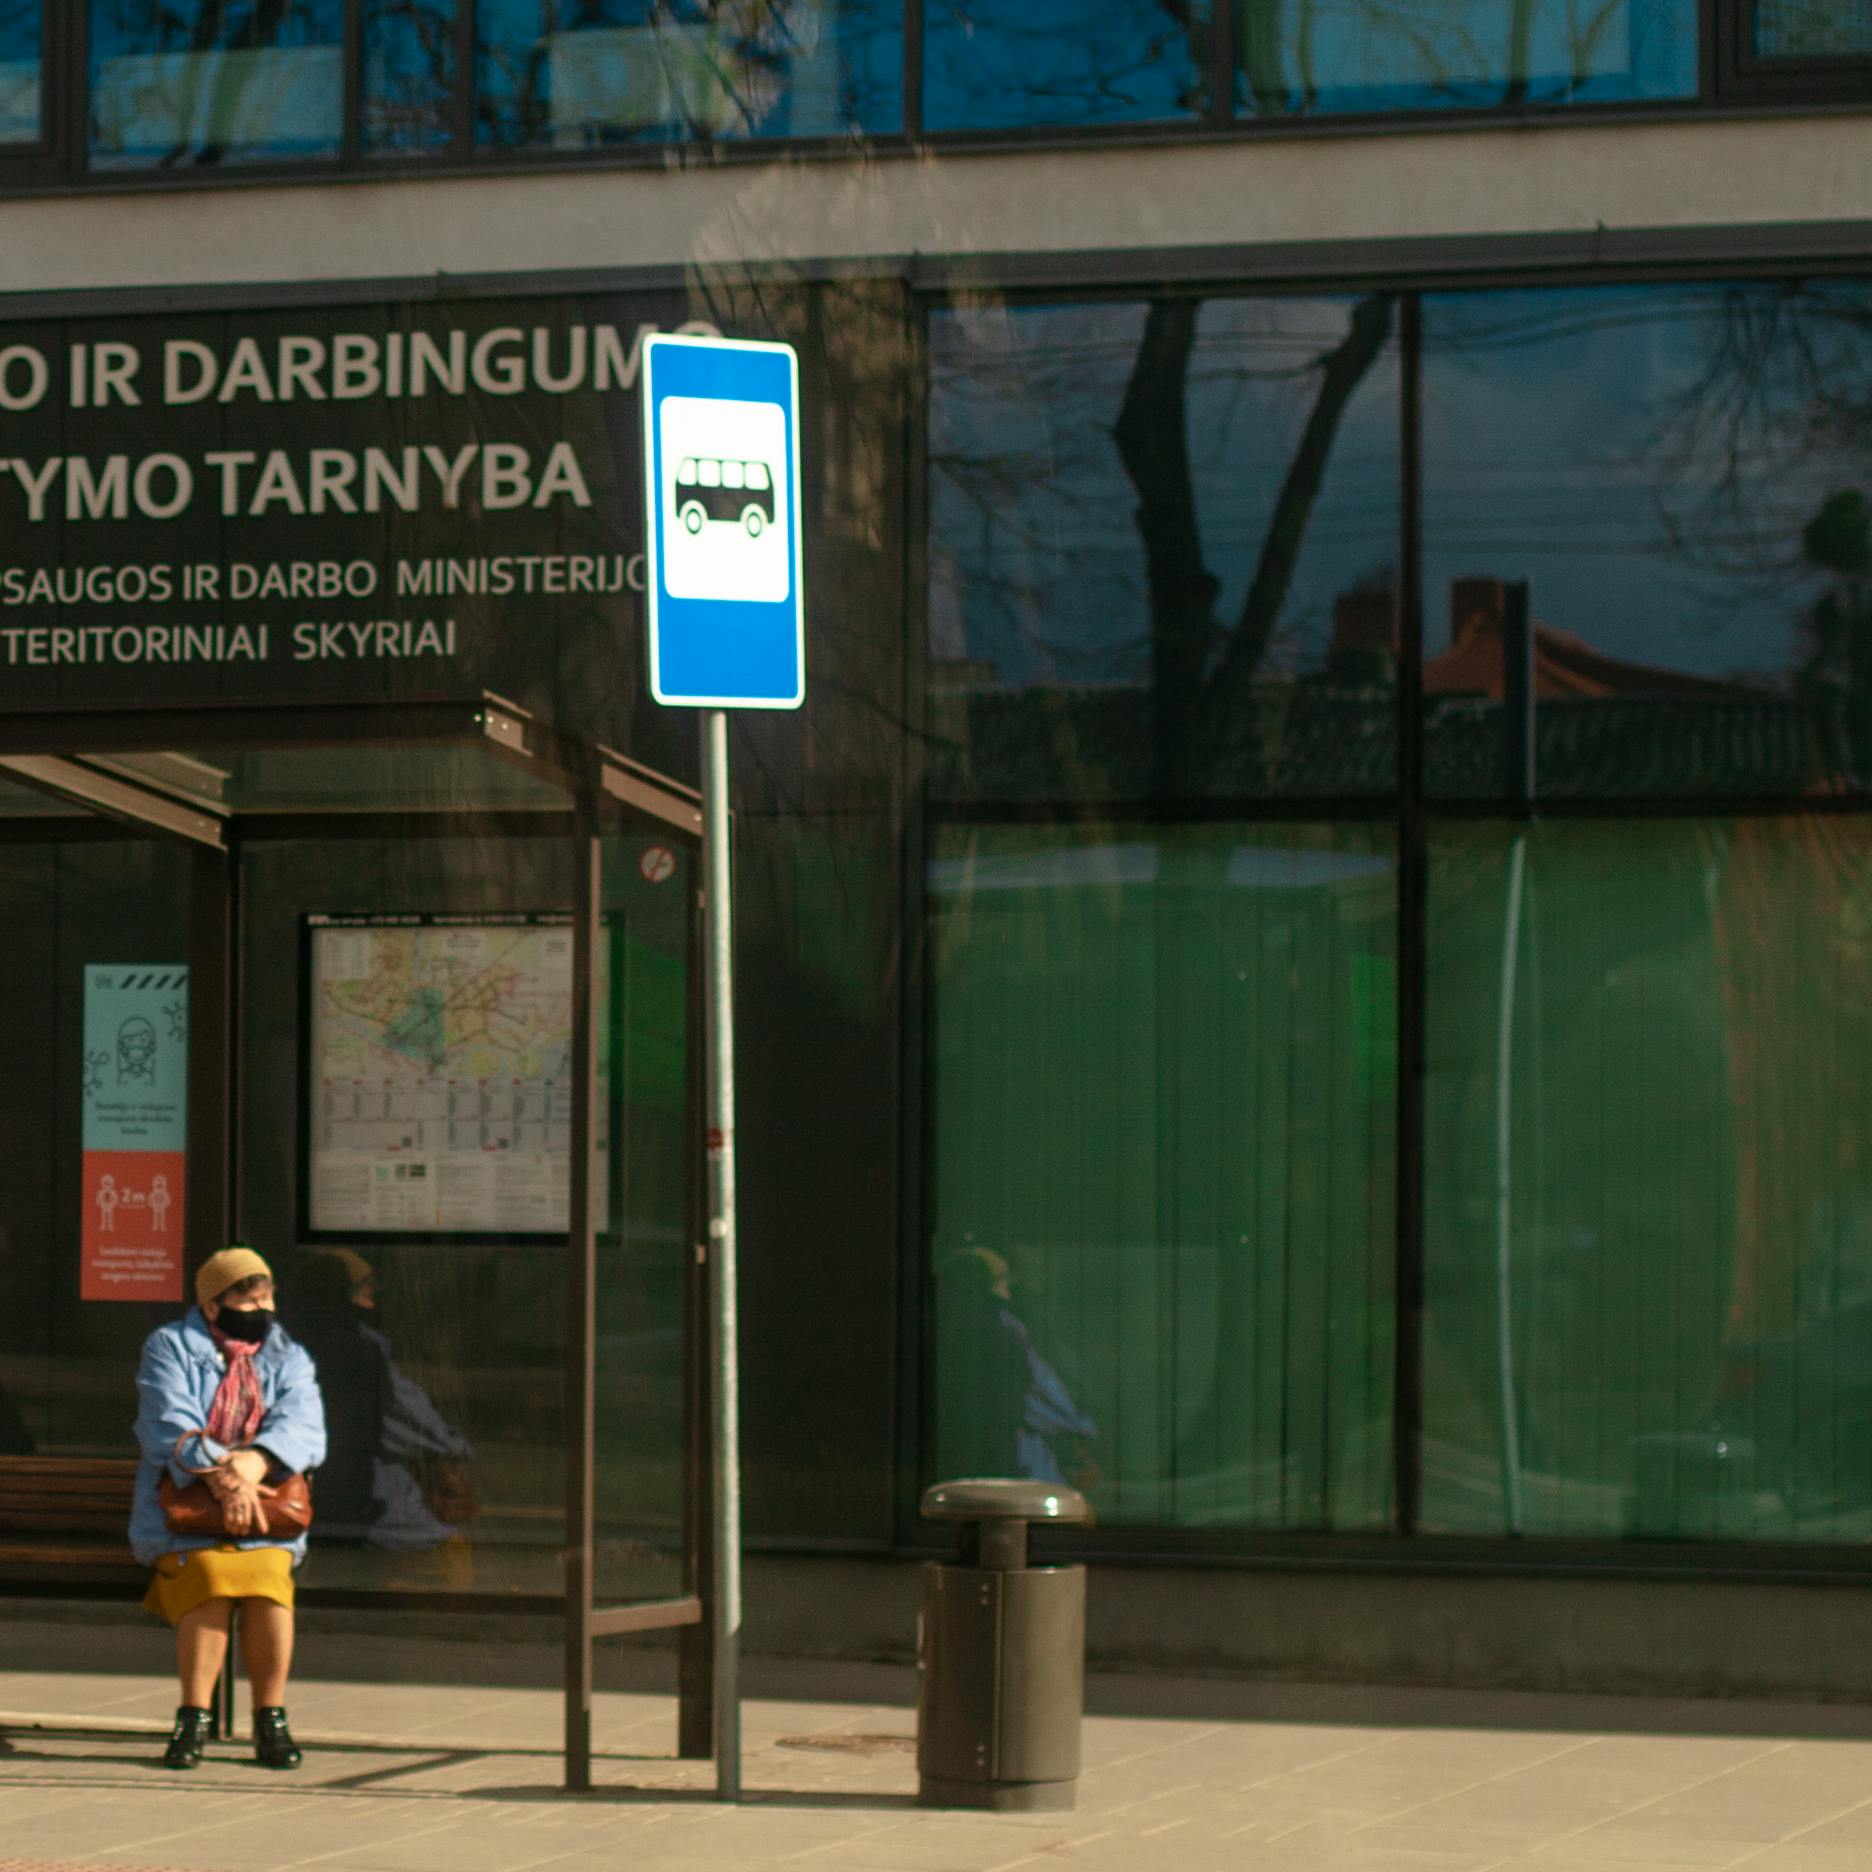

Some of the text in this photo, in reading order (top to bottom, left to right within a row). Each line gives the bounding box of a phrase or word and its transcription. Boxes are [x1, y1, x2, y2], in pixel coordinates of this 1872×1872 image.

[70, 342, 141, 407] IR
[164, 320, 725, 405] DARBINGUM
[204, 441, 592, 516] TARNYBA
[183, 564, 221, 601] IR
[230, 559, 378, 600] DARBO
[0, 622, 268, 666] TERITORINIAI
[293, 620, 456, 660] SKYRIAI
